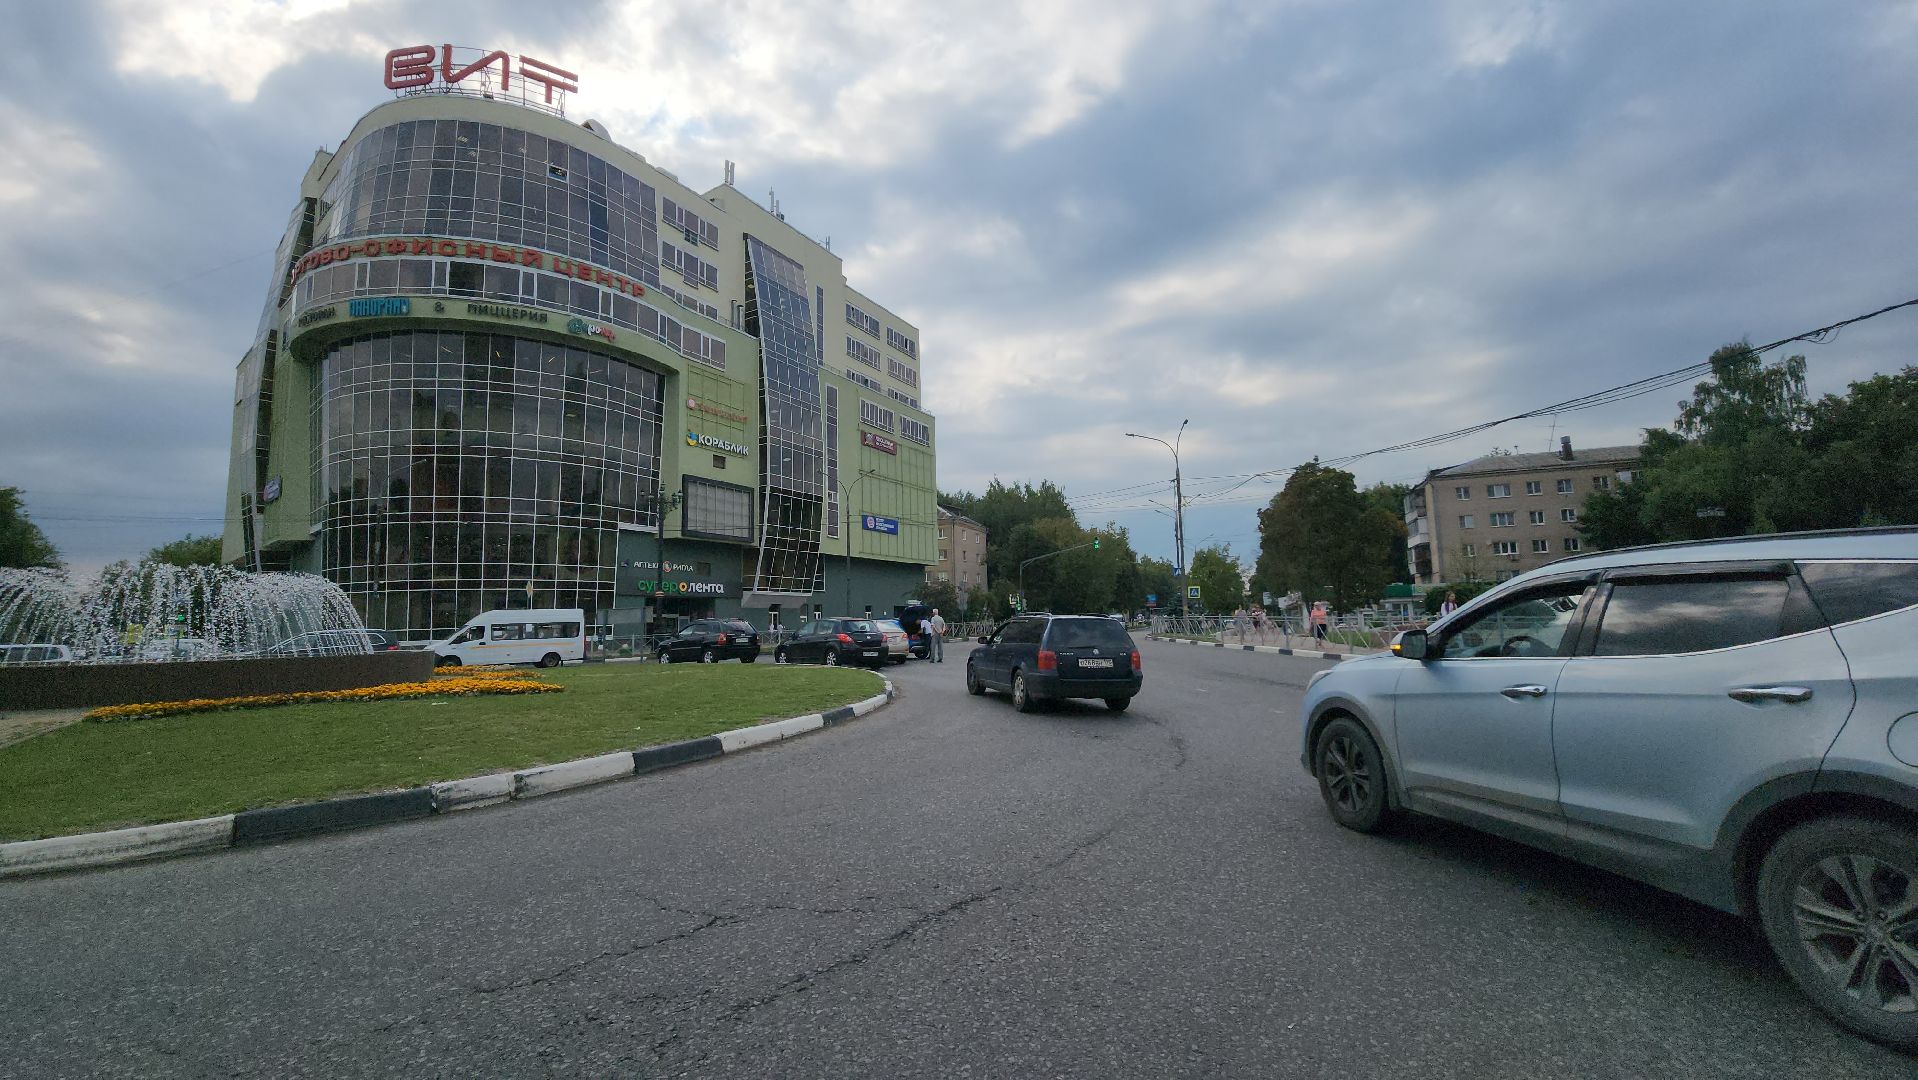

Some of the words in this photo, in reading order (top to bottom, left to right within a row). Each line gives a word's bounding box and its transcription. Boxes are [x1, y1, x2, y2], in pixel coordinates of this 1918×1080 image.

[384, 44, 578, 104] ВИТ
[291, 239, 544, 285] РГОВО-ОФИСНЫЙ
[553, 256, 646, 297] ЦЕНТР
[467, 303, 548, 323] ПИЦЦЕРИЯ
[698, 433, 749, 456] КОРАБЛИК
[688, 582, 724, 594] лента
